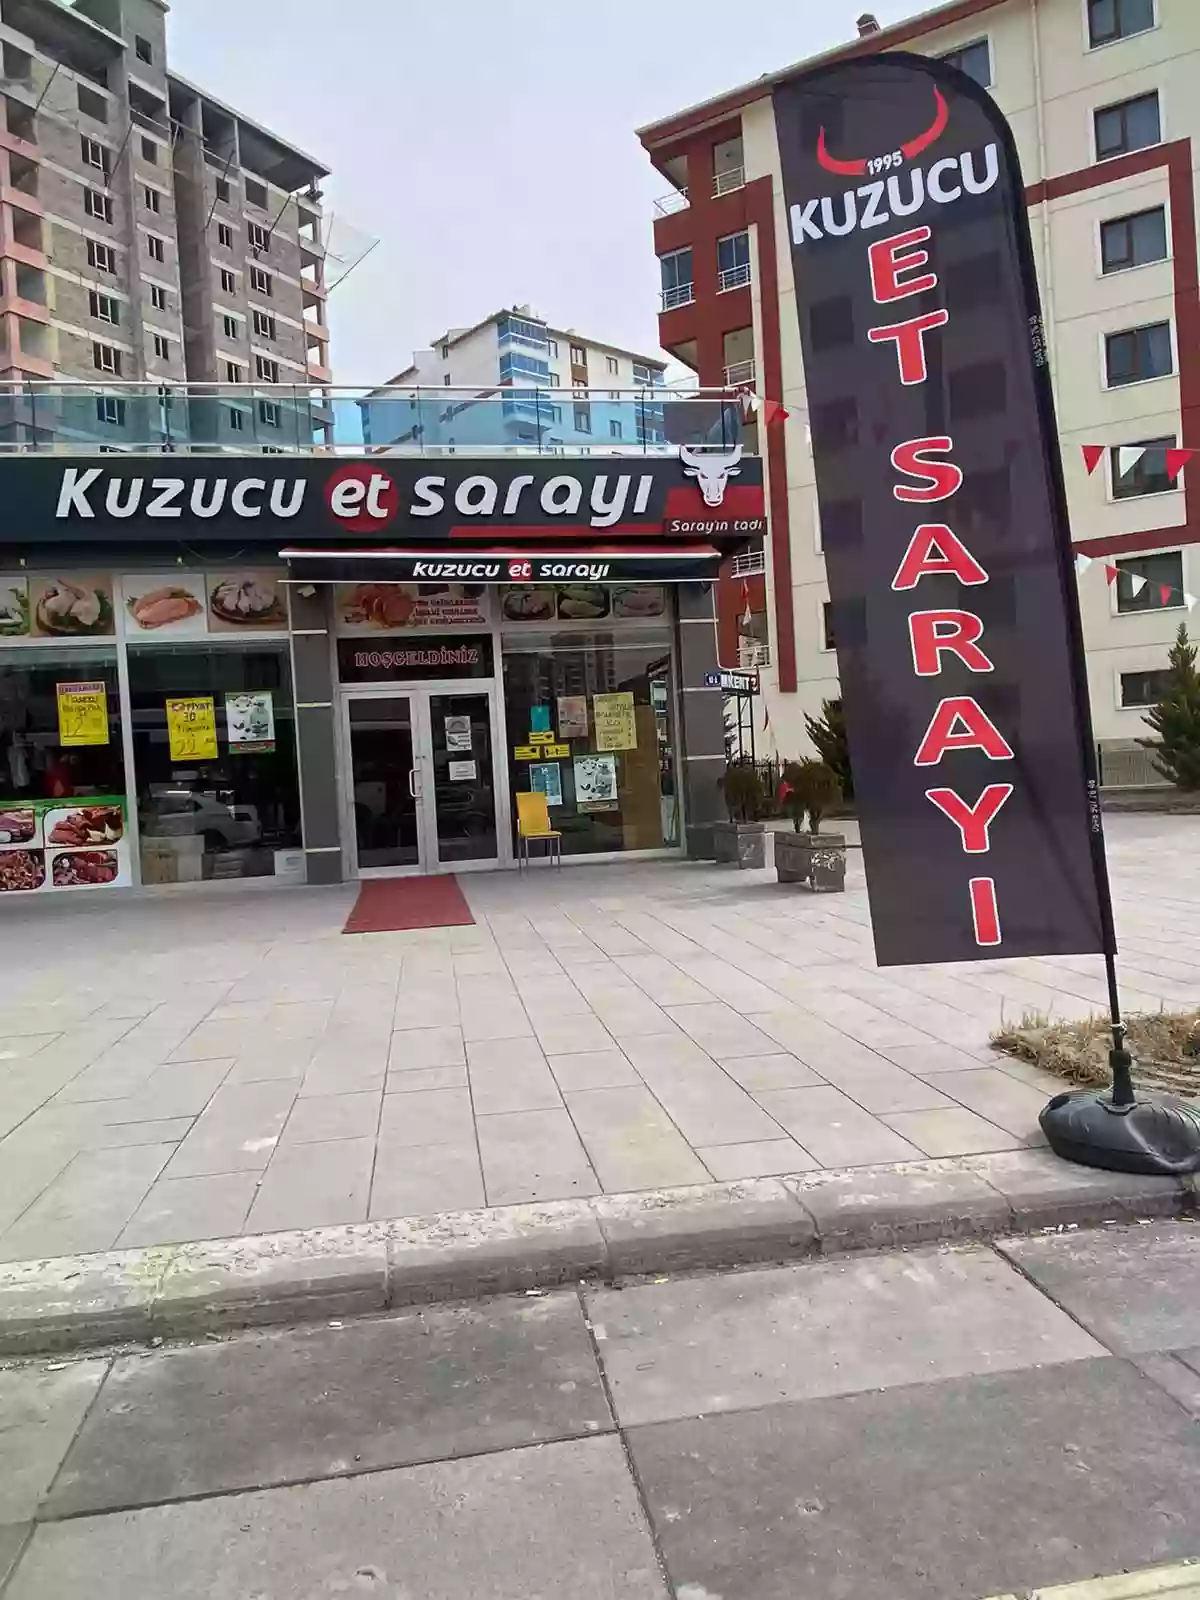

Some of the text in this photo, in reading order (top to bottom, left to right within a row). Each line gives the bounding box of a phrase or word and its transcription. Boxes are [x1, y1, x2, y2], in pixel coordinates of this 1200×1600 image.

[866, 150, 903, 177] 1995
[790, 143, 999, 245] KUZUCU
[331, 474, 391, 518] et
[410, 474, 653, 528] sarayı
[508, 563, 531, 577] et
[867, 225, 1015, 946] ET SARAYI
